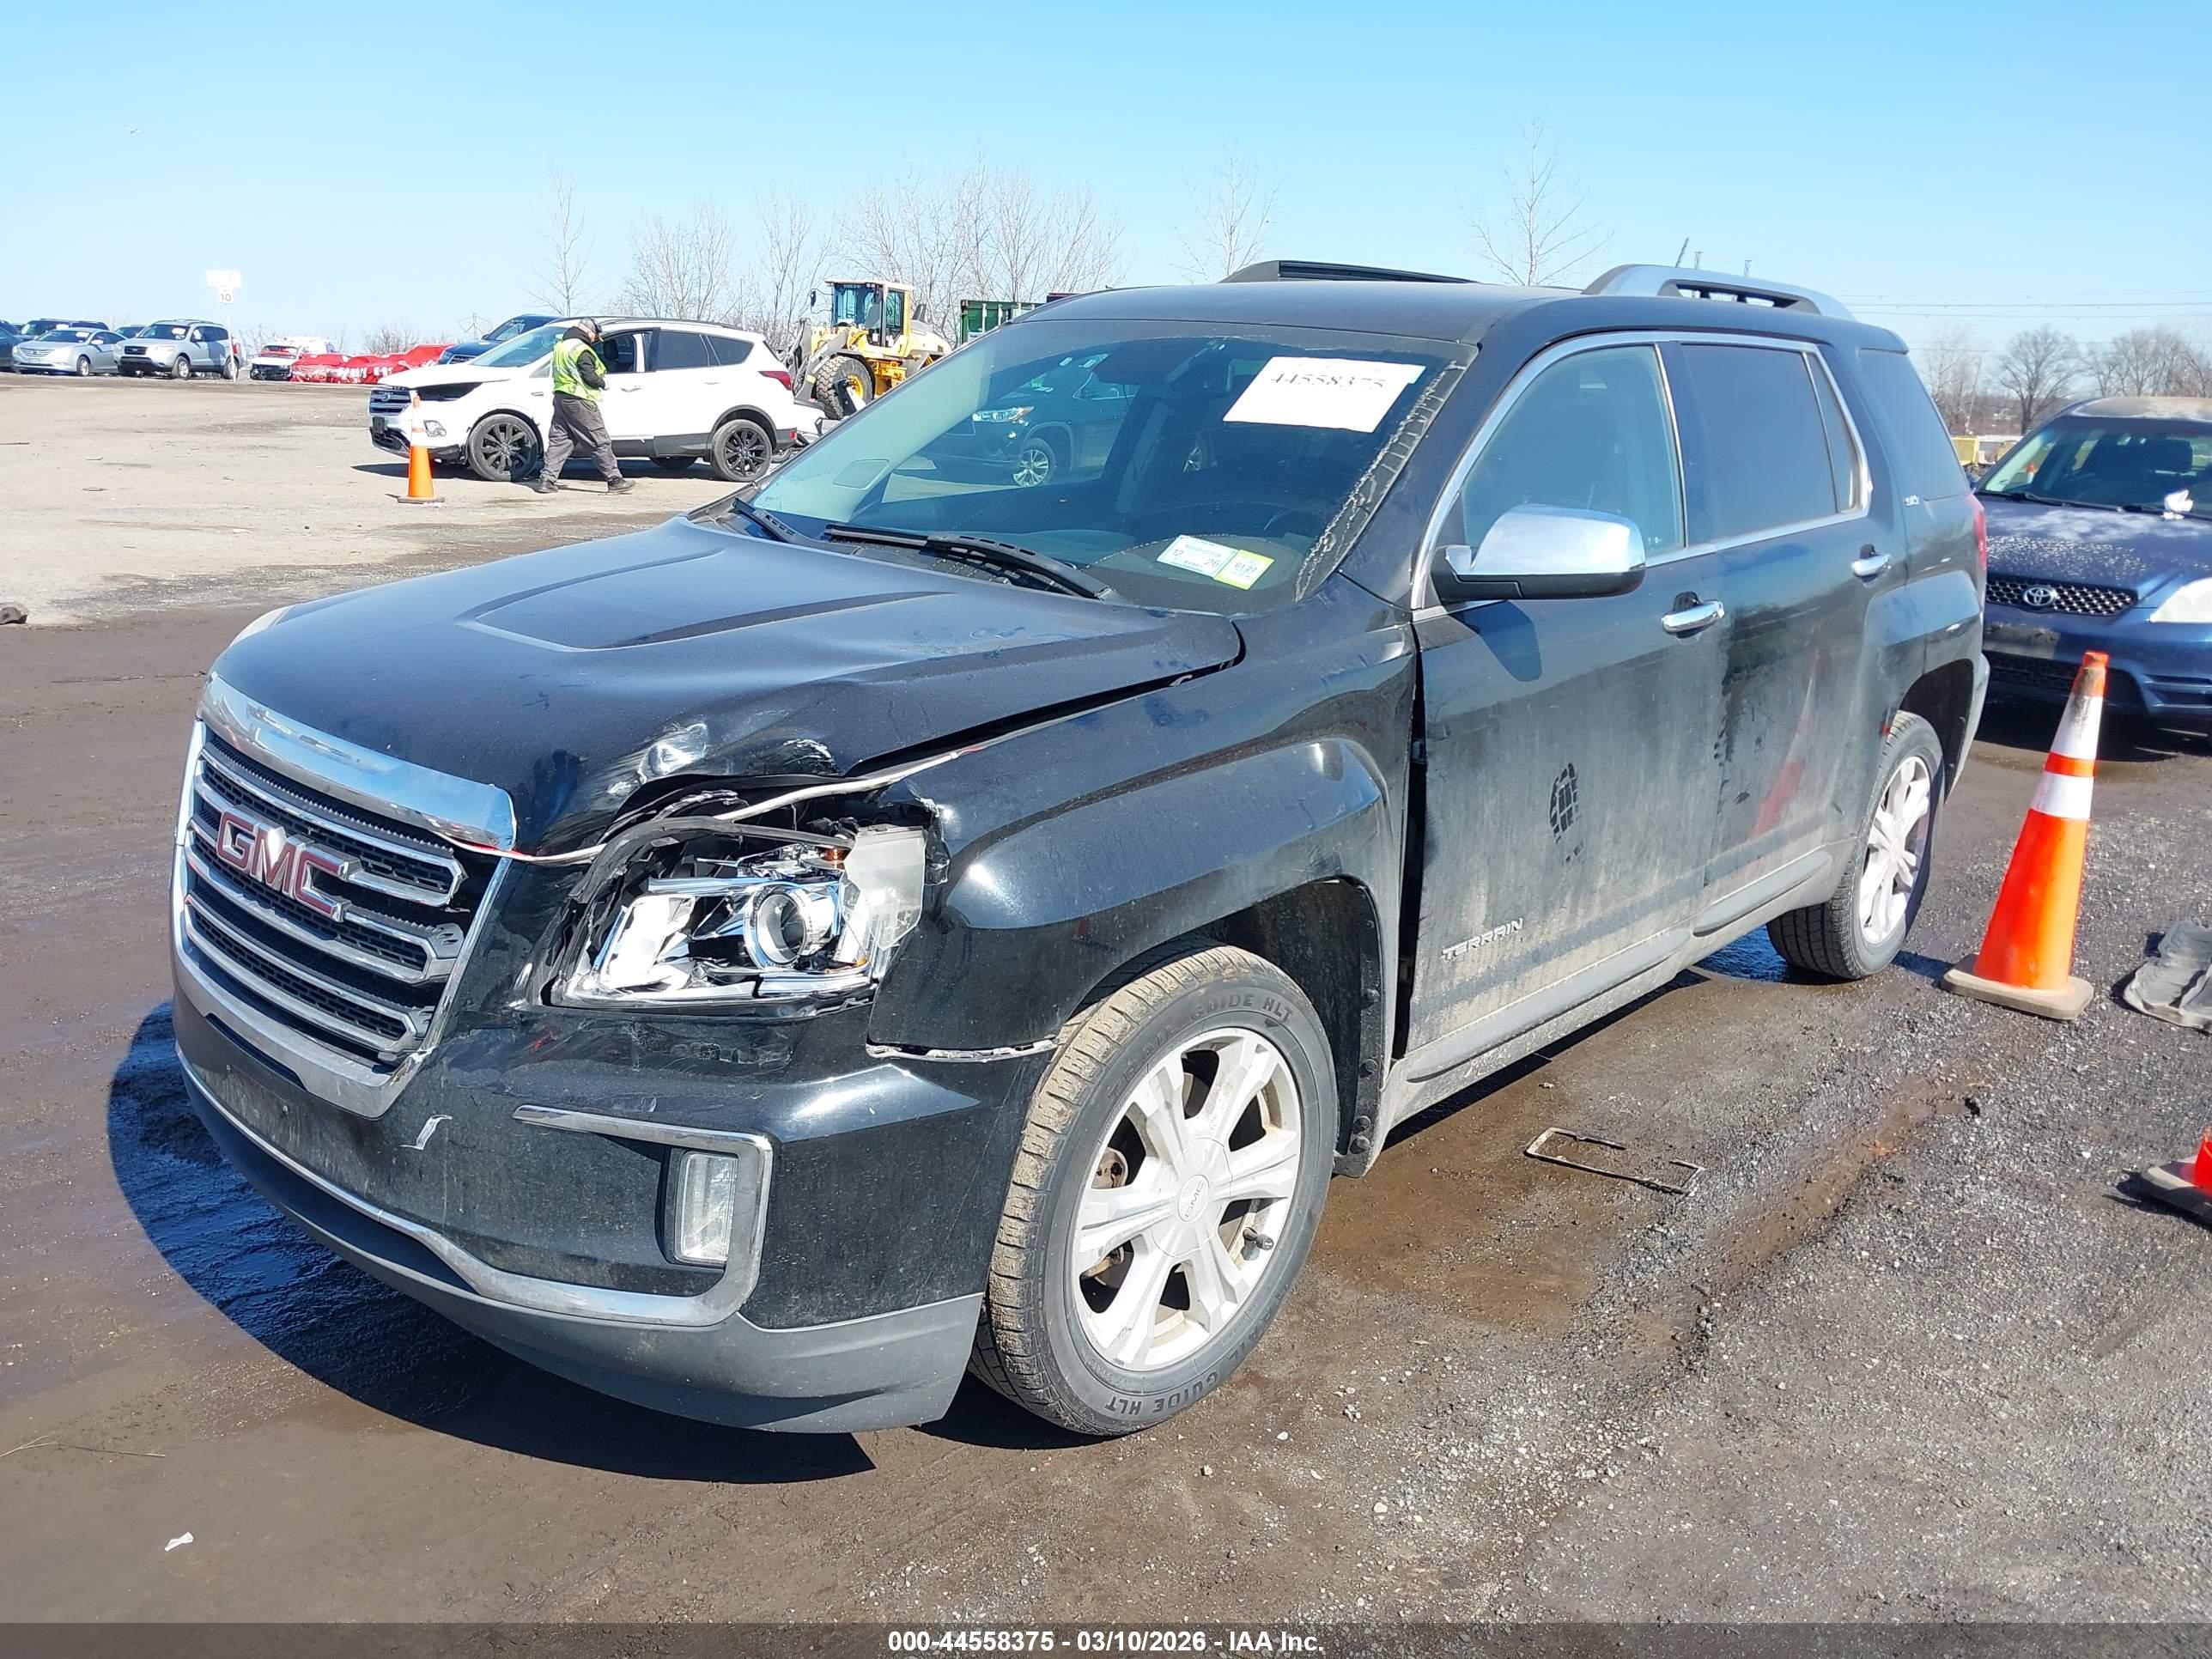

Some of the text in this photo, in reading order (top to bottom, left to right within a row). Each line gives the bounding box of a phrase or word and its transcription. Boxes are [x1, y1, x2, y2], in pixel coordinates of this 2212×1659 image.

[216, 808, 357, 923] GMC
[1442, 917, 1523, 960] TERRAIN
[1262, 996, 1293, 1024] HLT
[1104, 1395, 1142, 1415] HLT
[1152, 1371, 1218, 1413] GUIDE
